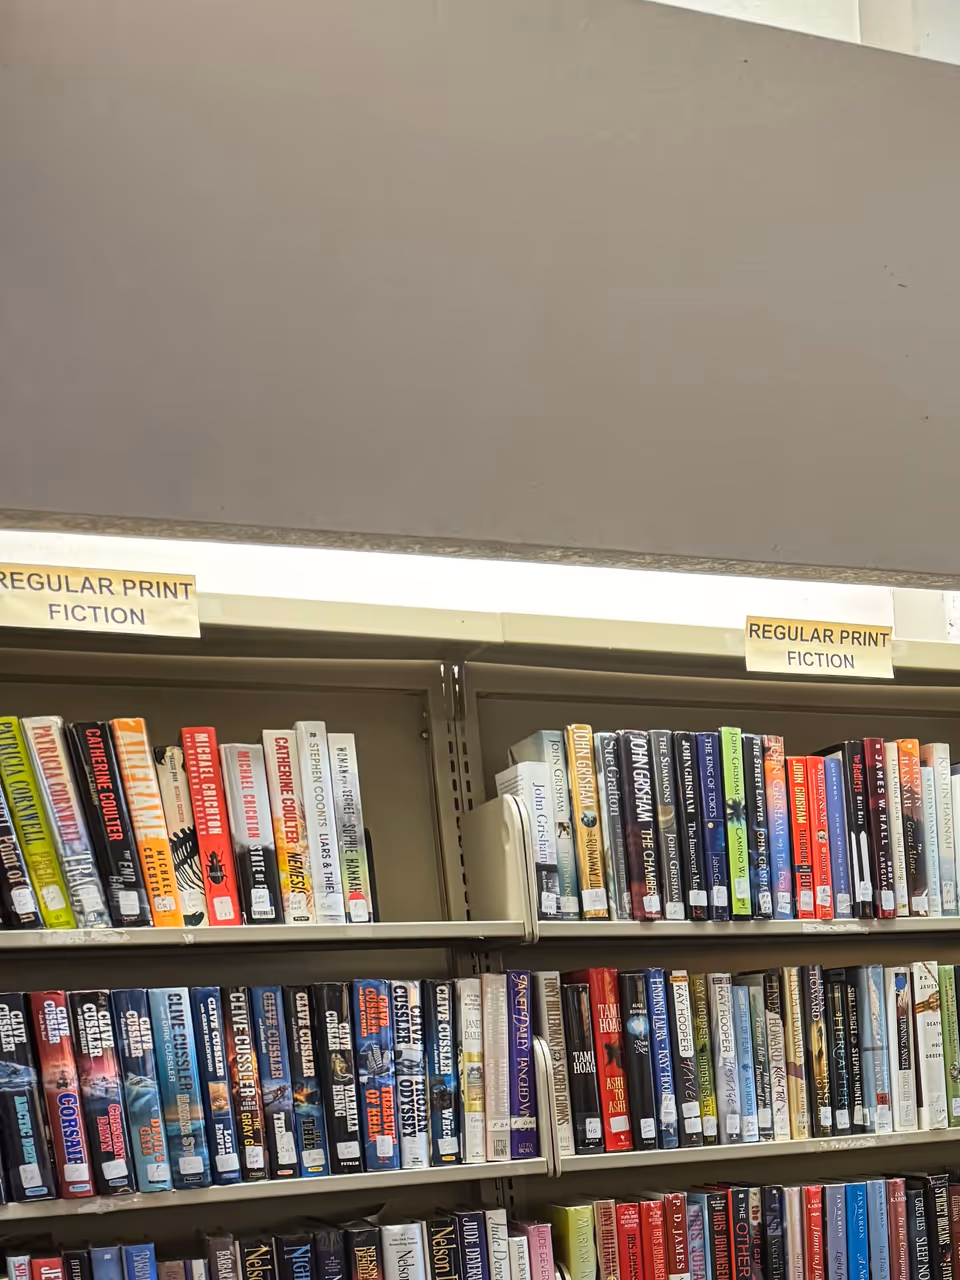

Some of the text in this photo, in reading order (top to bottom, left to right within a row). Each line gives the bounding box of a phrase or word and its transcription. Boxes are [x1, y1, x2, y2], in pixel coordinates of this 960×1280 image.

[48, 603, 146, 625] FICTION
[122, 579, 193, 600] PRINT
[749, 622, 890, 647] REGULAR PRINT
[787, 650, 855, 669] FICTION
[32, 725, 81, 843] PATRICIA CORNWELL
[86, 728, 124, 841] CATHERINE COULTER
[117, 731, 167, 841] AIRFRAME
[194, 733, 223, 835] MICHAEL CRICHTON
[275, 737, 298, 844] CATHERINE COULTER
[309, 743, 328, 827] STEPHEN COONTS
[573, 728, 595, 807] JOHN GRISHAM
[629, 735, 652, 822] JOHN GRISHAM
[665, 833, 680, 902] JOHN GRISHAM
[83, 1003, 102, 1057] CUSSLER
[98, 1010, 114, 1048] CLIVE
[326, 1011, 341, 1051] CUSSLER
[339, 1023, 352, 1050] CLIVE
[718, 986, 730, 1053] KAY HOOPER
[333, 1085, 345, 1116] RISING
[344, 1084, 358, 1132] VALHALLA
[97, 1116, 113, 1151] DAWN
[109, 1104, 125, 1160] CRESCENT
[735, 1222, 750, 1277] OTHER
[915, 1237, 928, 1263] SLEEP
[917, 1265, 929, 1279] NO
